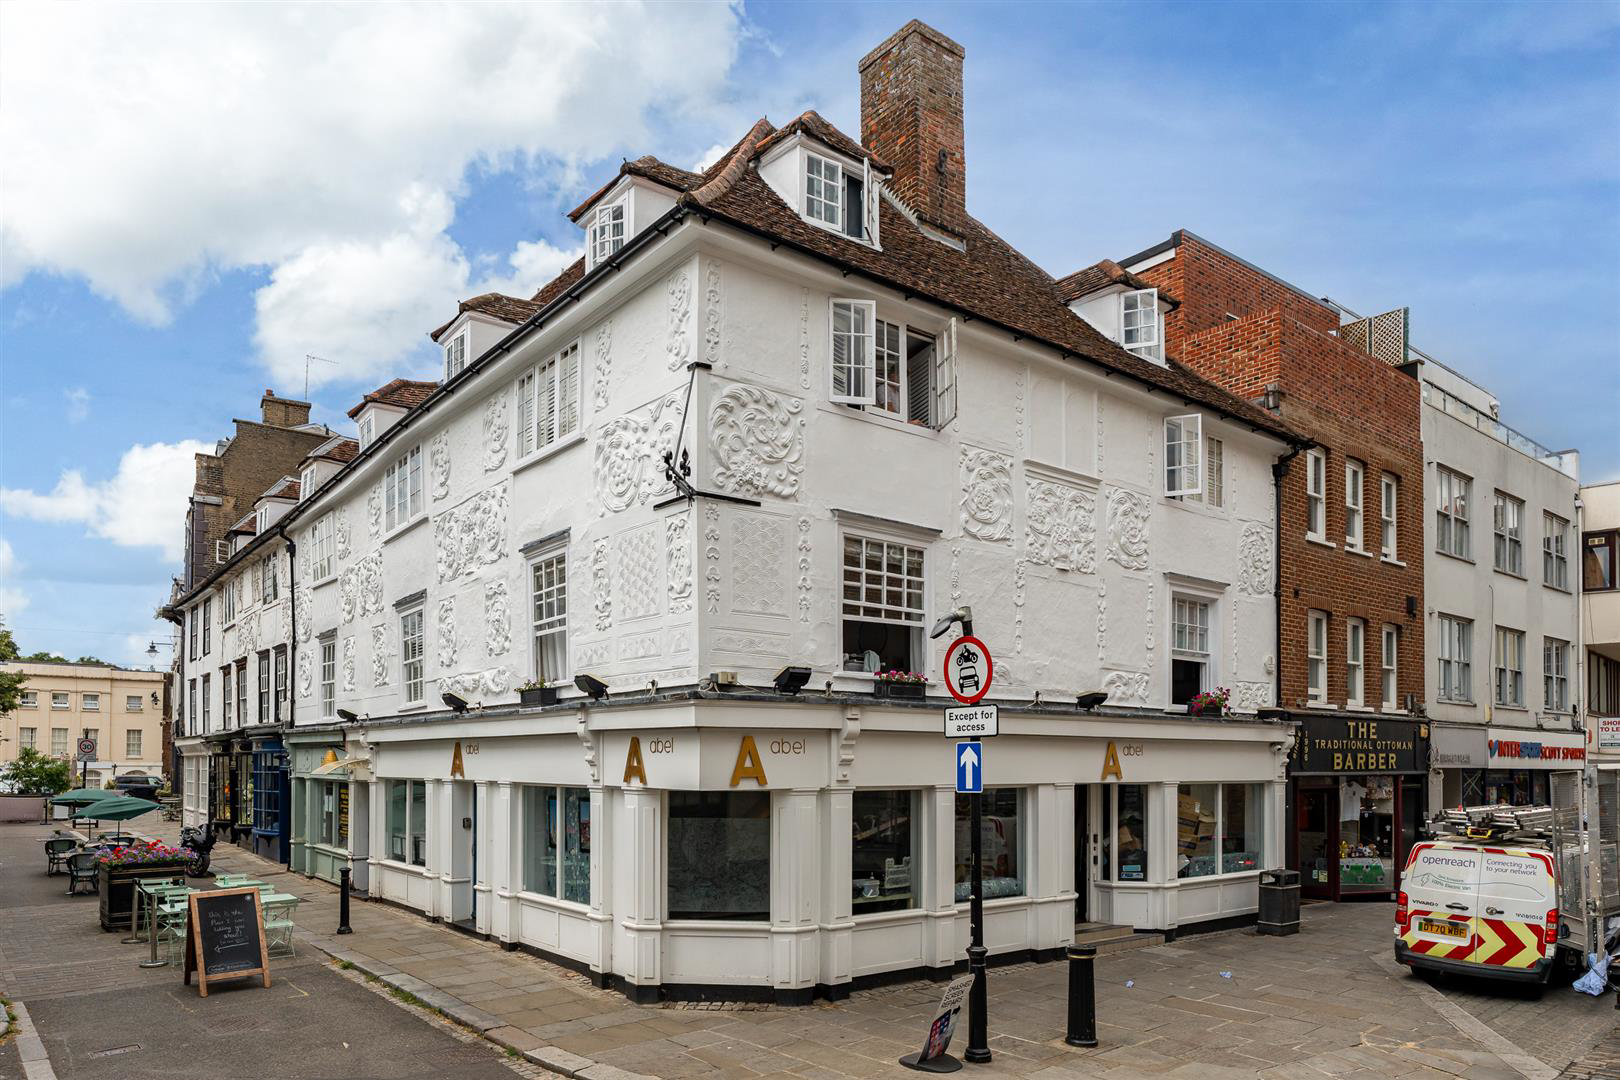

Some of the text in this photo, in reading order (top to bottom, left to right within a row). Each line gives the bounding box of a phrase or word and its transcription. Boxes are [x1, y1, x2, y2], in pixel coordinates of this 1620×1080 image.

[948, 710, 994, 721] Except for
[956, 723, 985, 732] access
[1347, 721, 1377, 739] THE
[1315, 739, 1413, 751] TRADITIONAL OTTOMAN
[450, 741, 480, 778] A abel
[622, 736, 674, 785] A abel
[730, 735, 806, 786] A abel
[1562, 747, 1585, 760] SPORTS
[1101, 741, 1144, 781] A abel
[1333, 752, 1397, 770] BARBER
[1422, 855, 1476, 868] openreach
[1486, 858, 1538, 870] Connecting you
[1494, 866, 1509, 874] your
[1510, 868, 1537, 876] network
[1423, 922, 1465, 938] DT70 WBF
